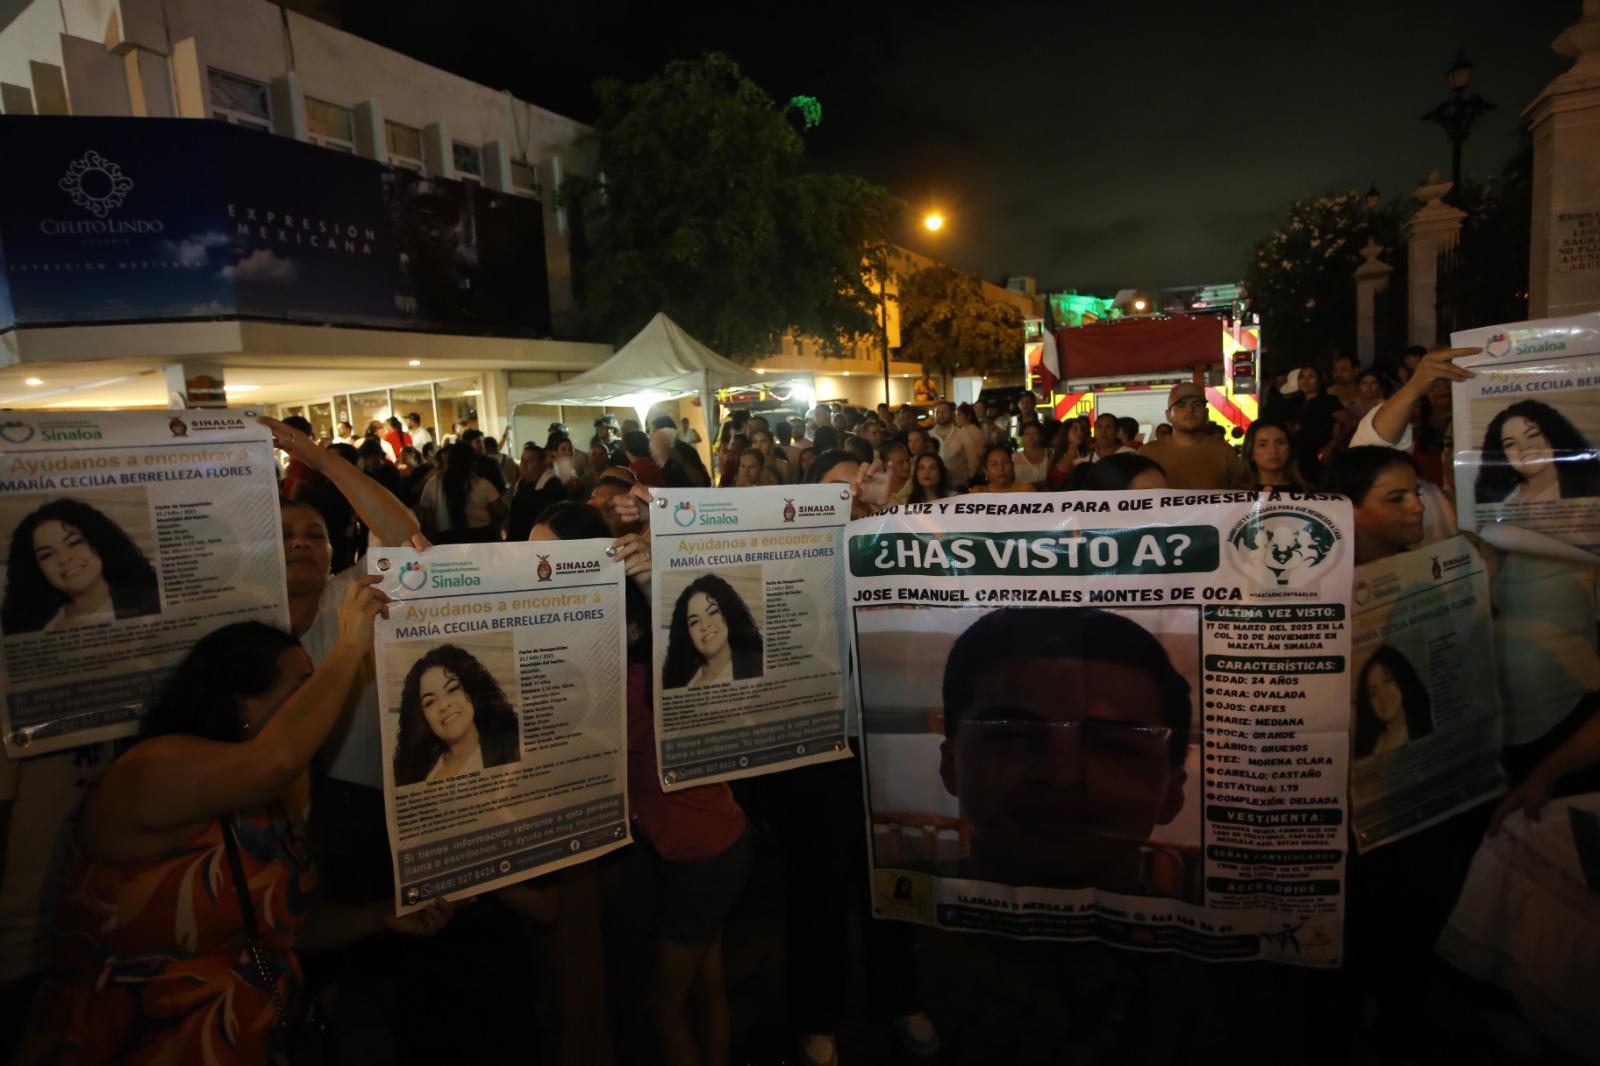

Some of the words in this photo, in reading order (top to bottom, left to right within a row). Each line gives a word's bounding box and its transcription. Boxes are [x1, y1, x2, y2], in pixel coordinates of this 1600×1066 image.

[109, 218, 164, 233] LINDO
[228, 203, 375, 241] EXPRESIÓN
[237, 222, 372, 255] MEXICANA
[1516, 341, 1566, 355] Sinaloa
[1481, 382, 1522, 396] MARÍA
[1525, 378, 1573, 391] CECILIA
[191, 418, 244, 427] SINALOA
[41, 429, 103, 442] Sinaloa
[10, 456, 120, 476] Ayúdanos
[127, 455, 138, 466] a
[144, 449, 233, 465] encontrar
[0, 475, 56, 491] MARÍA
[60, 473, 117, 488] CECILIA
[120, 468, 202, 484] BERRELLEZA
[206, 464, 252, 479] FLORES
[799, 504, 836, 513] SINALOA
[904, 503, 933, 515] LUZ
[939, 503, 950, 514] Y
[955, 502, 1055, 515] ESPERANZA
[1061, 501, 1111, 513] PARA
[1118, 498, 1153, 512] QUE
[1160, 491, 1259, 508] REGRESEN
[700, 513, 739, 526] Sinaloa
[678, 535, 746, 554] Ayúdanos
[750, 537, 758, 547] a
[762, 532, 822, 546] encontrar
[670, 553, 705, 568] MARÍA
[707, 551, 743, 565] CECILIA
[745, 548, 801, 562] BERRELLEZA
[803, 546, 835, 558] FLORES
[874, 538, 976, 570] ¿HAS
[985, 537, 1119, 569] VISTO
[1131, 533, 1192, 567] A?
[556, 560, 600, 571] SINALOA
[432, 573, 481, 588] Sinaloa
[853, 588, 892, 601] JOSE
[898, 588, 969, 601] EMANUEL
[975, 589, 1082, 602] CARRIZALES
[1089, 589, 1163, 602] MONTES
[1171, 587, 1195, 600] DE
[1202, 587, 1242, 600] OCA
[405, 598, 492, 621] Ayúdanos
[497, 600, 507, 611] a
[512, 591, 587, 610] encontrar
[1217, 606, 1263, 618] ÚLTIMA
[1267, 608, 1292, 618] VEZ
[1296, 607, 1335, 617] VISTO:
[395, 621, 440, 638] MARÍA
[443, 619, 489, 634] CECILIA
[492, 612, 561, 629] BERRELLEZA
[563, 609, 604, 623] FLORES
[1332, 622, 1344, 630] LA
[1268, 633, 1321, 641] NOVIEMBRE
[1227, 641, 1280, 650] MAZATLÁN
[1283, 642, 1323, 650] SINALOA
[1215, 675, 1248, 684] EDAD:
[1251, 676, 1265, 685] 24
[1269, 675, 1299, 685] AÑOS
[1216, 689, 1249, 698] CARA:
[1253, 690, 1306, 699] OVALADA
[1216, 702, 1246, 712] OJOS:
[1250, 704, 1286, 713] CAFES
[1216, 714, 1252, 726] NARIZ:
[1255, 718, 1304, 727] MEDIANA
[1216, 728, 1249, 739] BOCA:
[1252, 731, 1296, 740] GRANDE
[1216, 741, 1257, 752] LABIOS:
[1261, 744, 1309, 753] GRUESOS
[1216, 755, 1240, 763] TEZ:
[1248, 757, 1292, 766] MORENA
[1296, 757, 1333, 766] CLARA
[1216, 767, 1268, 780] CABELLO:
[1271, 768, 1322, 779] CASTAÑO
[1216, 781, 1277, 793] ESTATURA:
[1290, 797, 1338, 806] DELGADA
